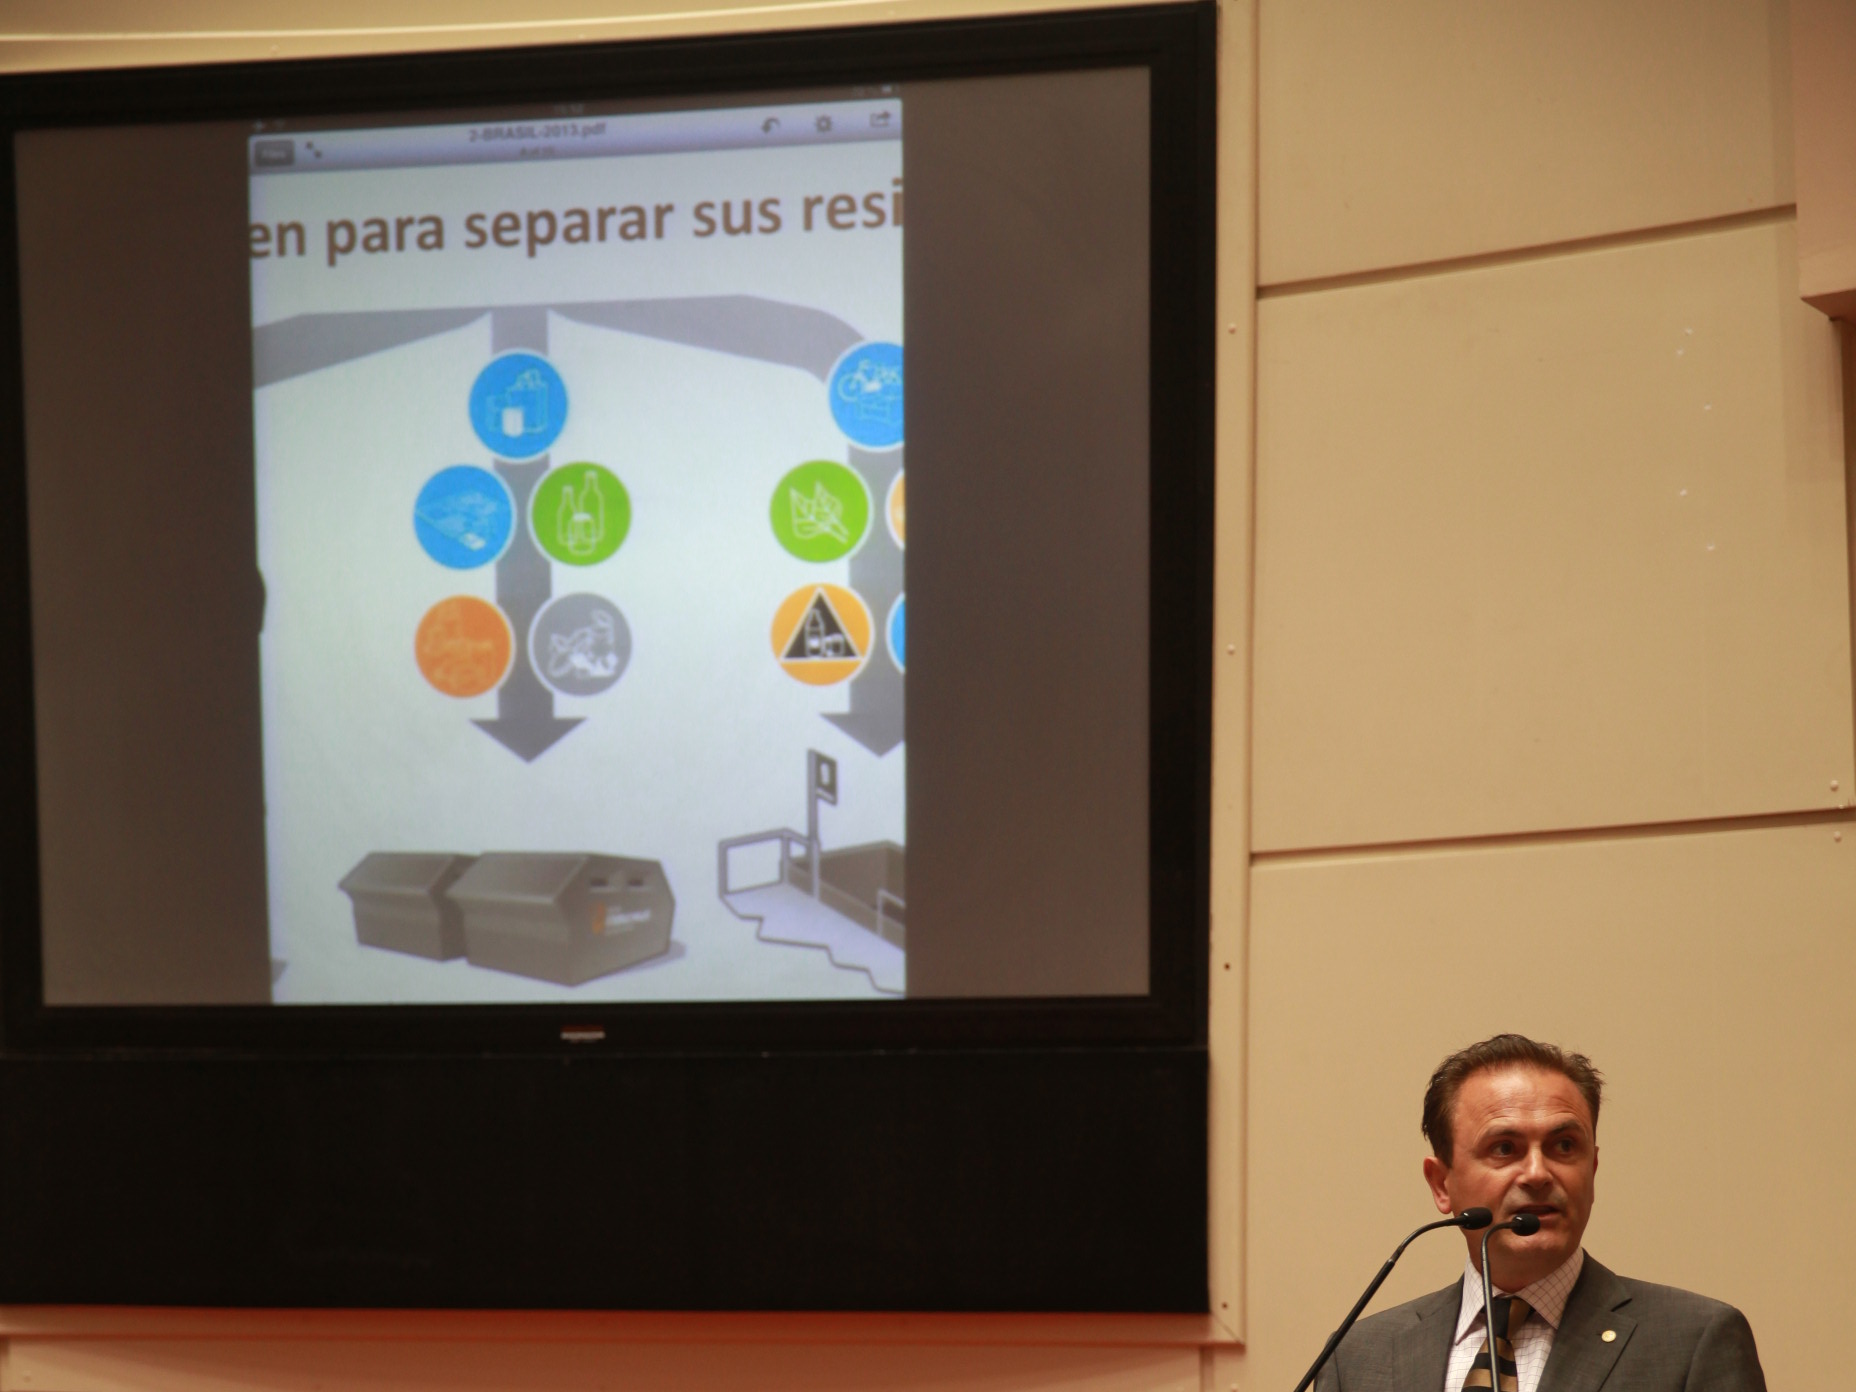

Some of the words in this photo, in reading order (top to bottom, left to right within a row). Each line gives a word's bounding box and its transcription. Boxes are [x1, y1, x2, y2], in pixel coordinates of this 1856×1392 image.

[250, 221, 305, 258] en
[327, 214, 444, 267] para
[464, 203, 674, 258] separar
[693, 197, 782, 237] sus
[803, 177, 903, 231] resi
